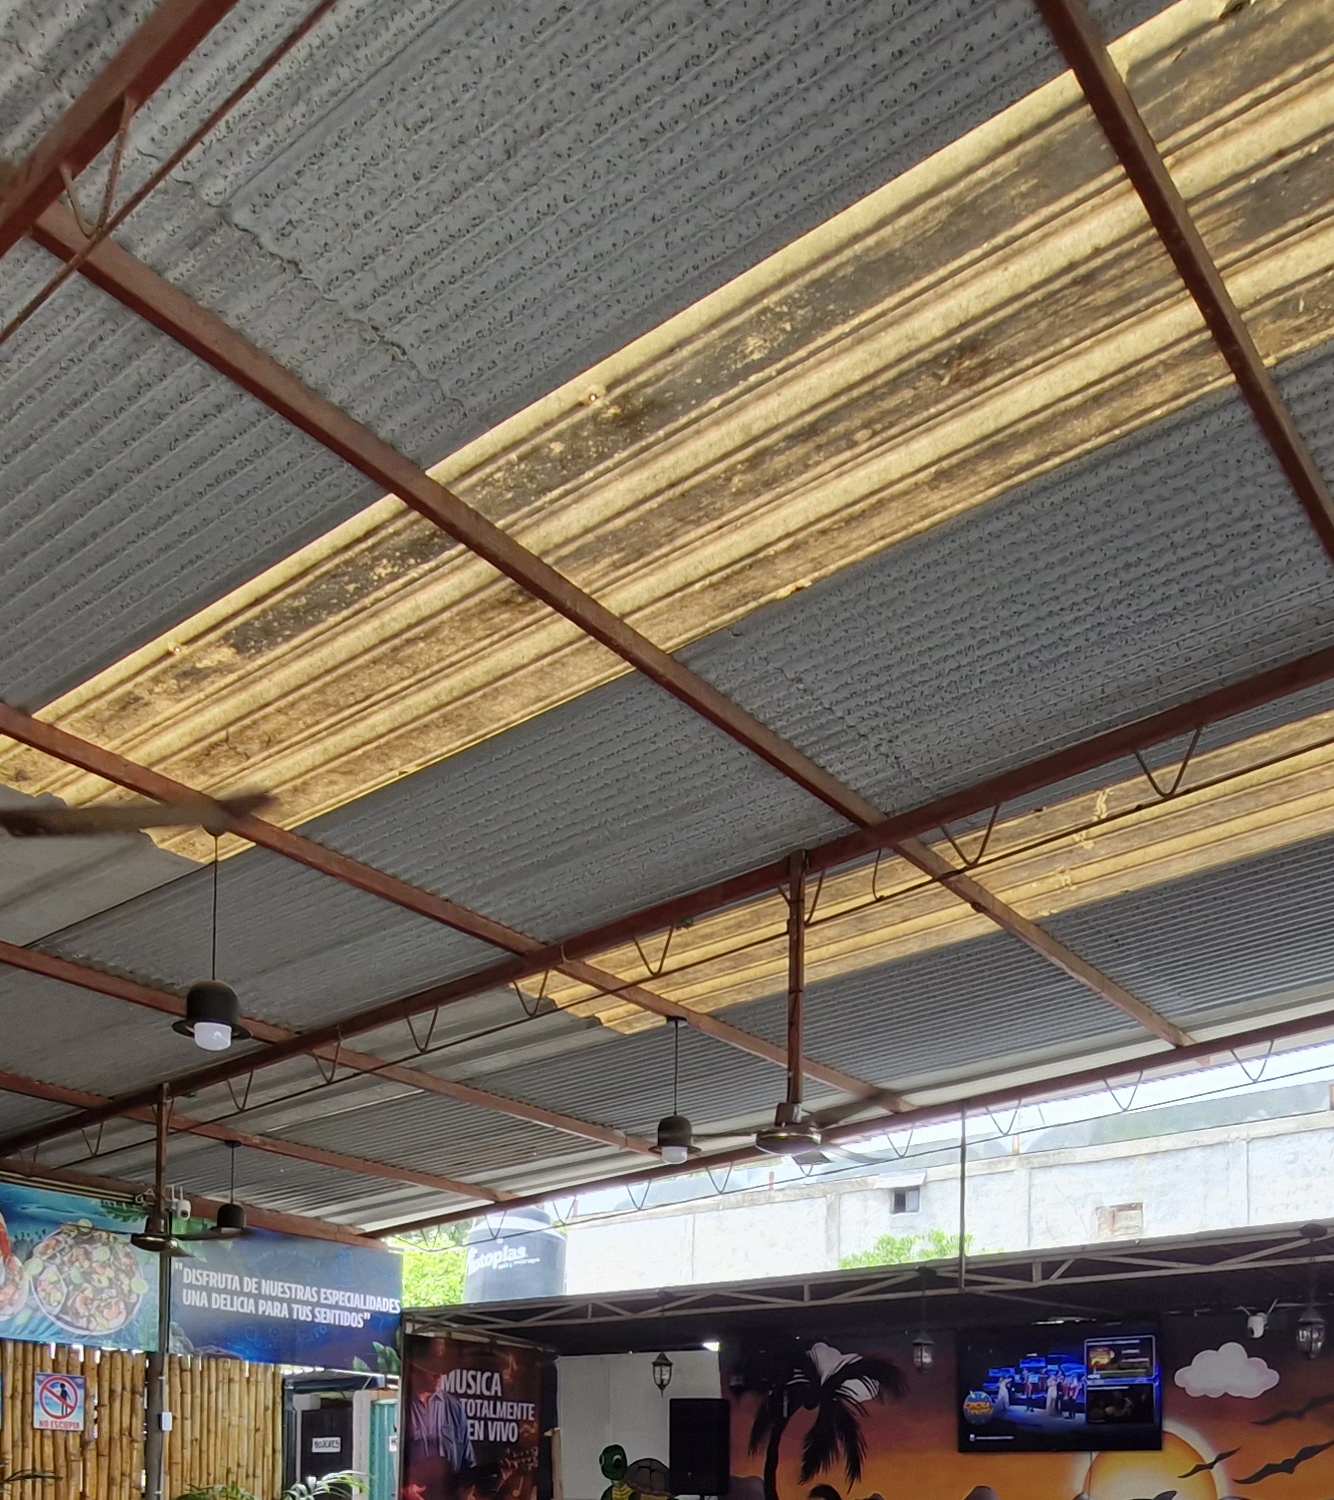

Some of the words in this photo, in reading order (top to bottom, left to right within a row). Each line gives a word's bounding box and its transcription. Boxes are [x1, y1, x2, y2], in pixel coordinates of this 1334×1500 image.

[175, 1262, 241, 1291] "DISFRUTA
[243, 1277, 259, 1294] DE
[261, 1280, 318, 1303] NUESTRAS
[320, 1288, 401, 1314] ESPECIALIDADES
[182, 1289, 208, 1308] UNA
[212, 1293, 255, 1314] DELICIA
[258, 1299, 289, 1319] PARA
[291, 1303, 313, 1322] TUS
[314, 1309, 371, 1329] SENTIDOS"
[440, 1369, 502, 1397] MUSICA
[459, 1399, 535, 1420] TOTALMENTE
[468, 1420, 484, 1440] EN
[488, 1421, 518, 1443] VIVO
